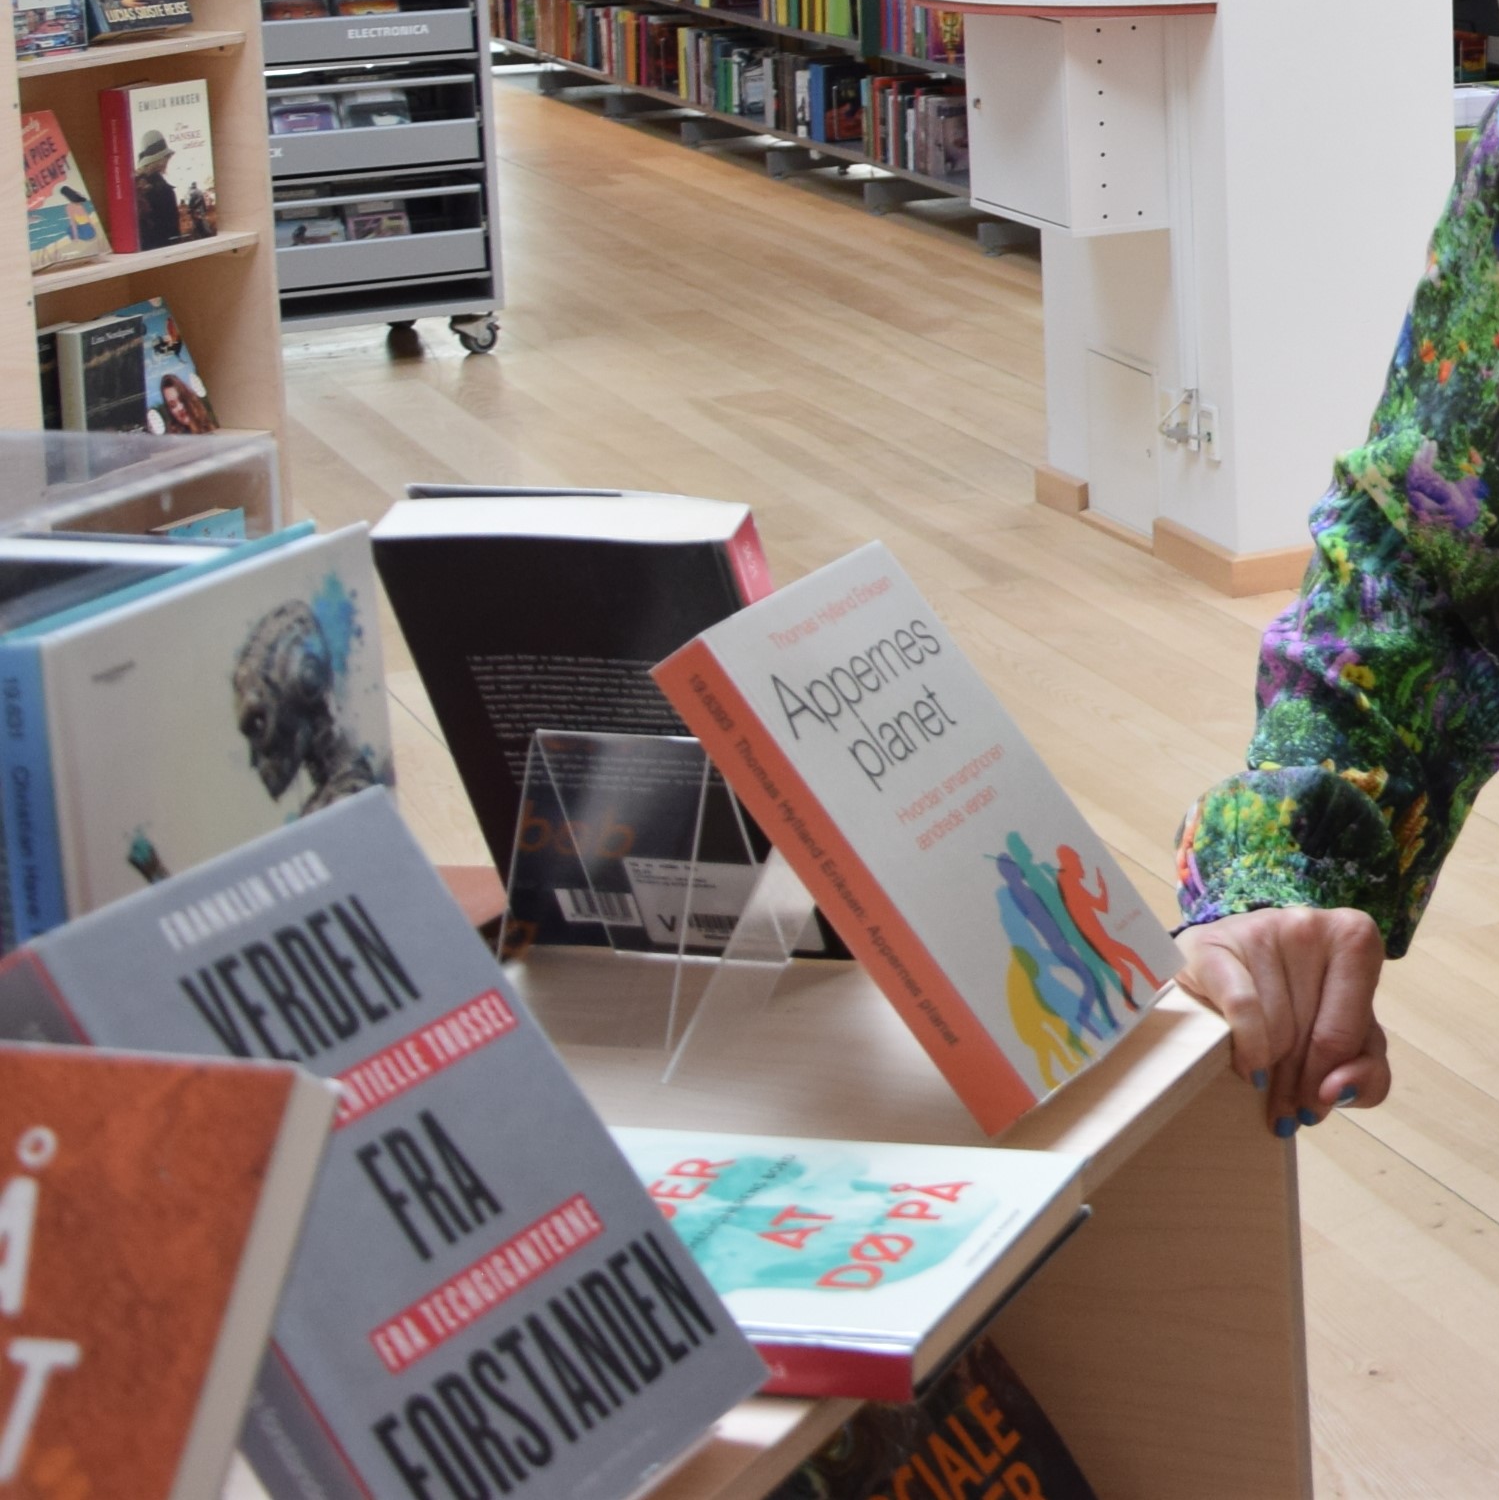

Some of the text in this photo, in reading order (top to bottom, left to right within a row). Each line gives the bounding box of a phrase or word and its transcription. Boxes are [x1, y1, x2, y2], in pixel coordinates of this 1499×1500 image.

[347, 24, 429, 40] ELECTRONICA
[31, 136, 58, 163] PIGE
[138, 92, 201, 112] EMILIA HANSEN
[768, 617, 821, 650] Thomas
[852, 575, 895, 604] Eriksen
[770, 620, 941, 741] Appernes
[848, 683, 957, 792] planet
[12, 764, 33, 859] Christian
[895, 786, 945, 827] Hvordan
[159, 849, 332, 951] FRANKLIN FOER
[658, 913, 677, 934] V
[734, 735, 781, 801] Thomas
[776, 801, 823, 861] Hylland
[819, 855, 867, 927] Eriksen:
[866, 923, 924, 999] Appernes
[916, 991, 960, 1048] planet
[178, 894, 422, 1062] VERDEN
[338, 993, 515, 1120] NTIELLE TRUSSEL
[355, 1109, 504, 1262] FRA
[647, 1158, 738, 1221] ER
[757, 1204, 836, 1252] AT
[815, 1230, 916, 1293] DØ
[885, 1180, 974, 1225] PÅ
[375, 1316, 428, 1369] FRA
[419, 1197, 600, 1337] TECHGIGANTERNE
[0, 1336, 82, 1486] T
[372, 1230, 718, 1500] FORSTANDEN
